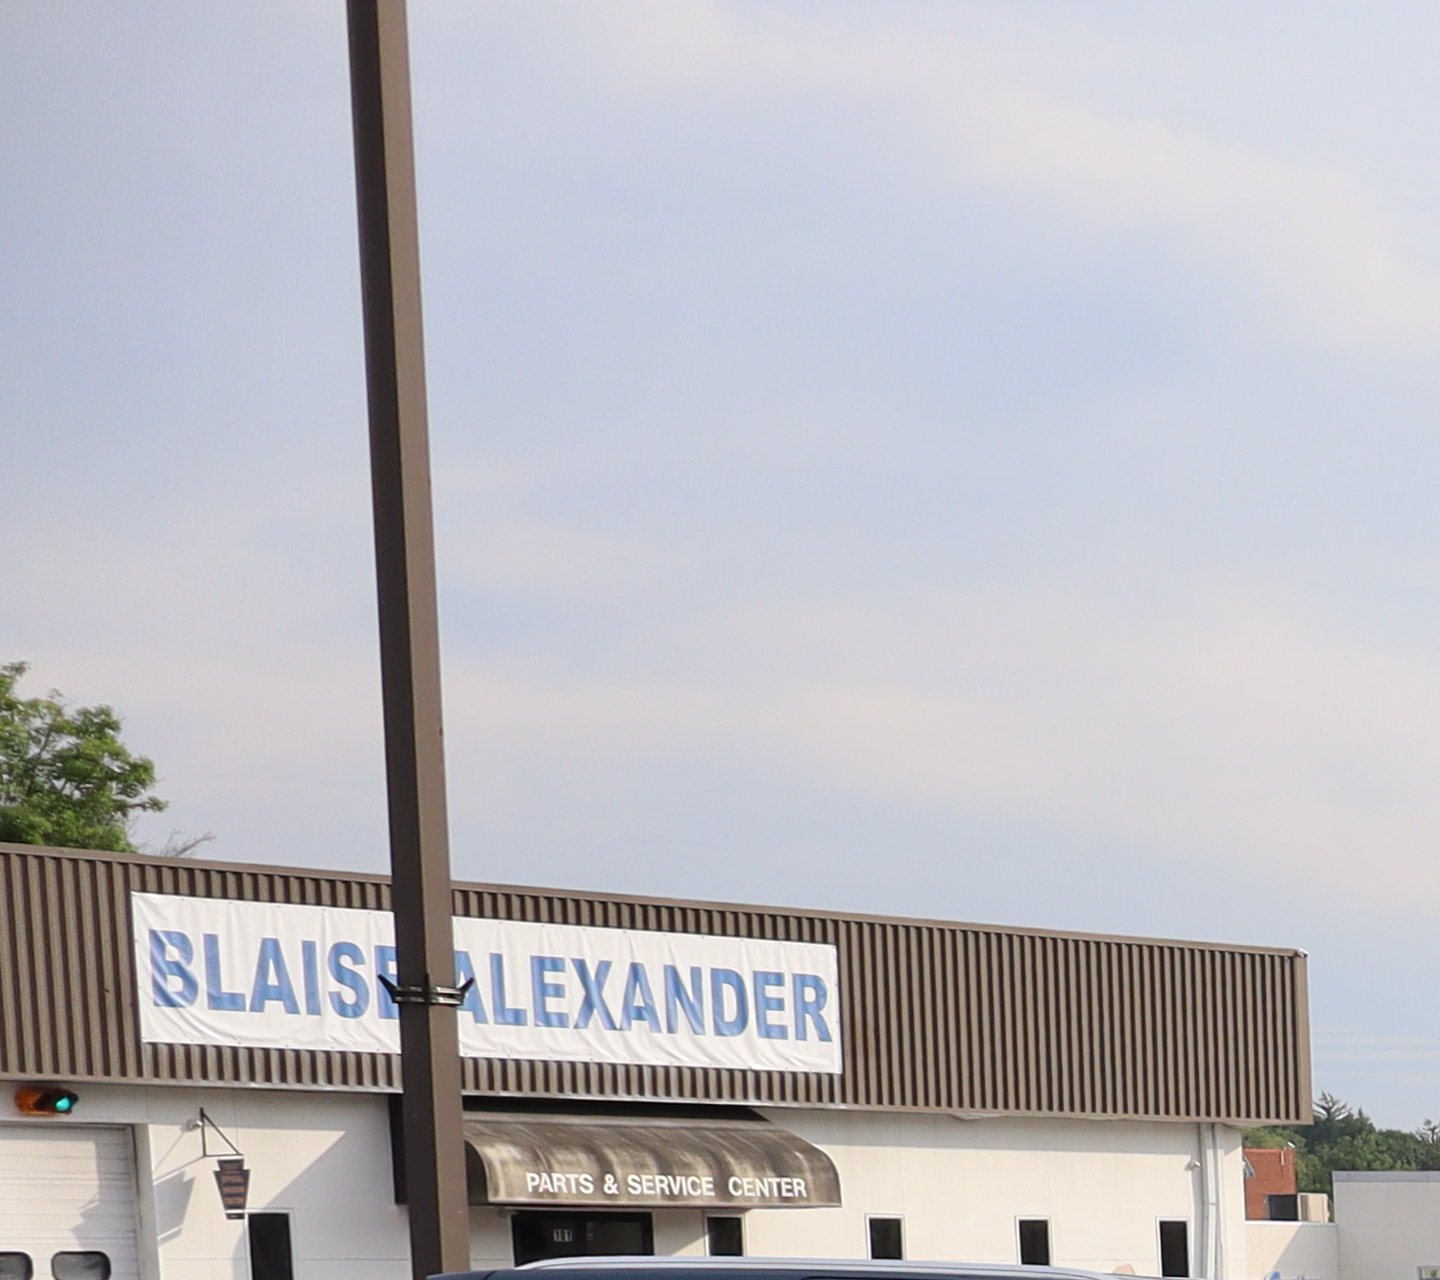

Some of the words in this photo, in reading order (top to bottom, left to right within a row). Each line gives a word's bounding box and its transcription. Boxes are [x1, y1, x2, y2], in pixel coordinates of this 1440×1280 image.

[453, 950, 833, 1042] ALEXANDER
[525, 1172, 594, 1195] PARTS
[603, 1173, 619, 1195] &
[627, 1174, 715, 1197] SERVICE
[727, 1176, 807, 1198] CENTER
